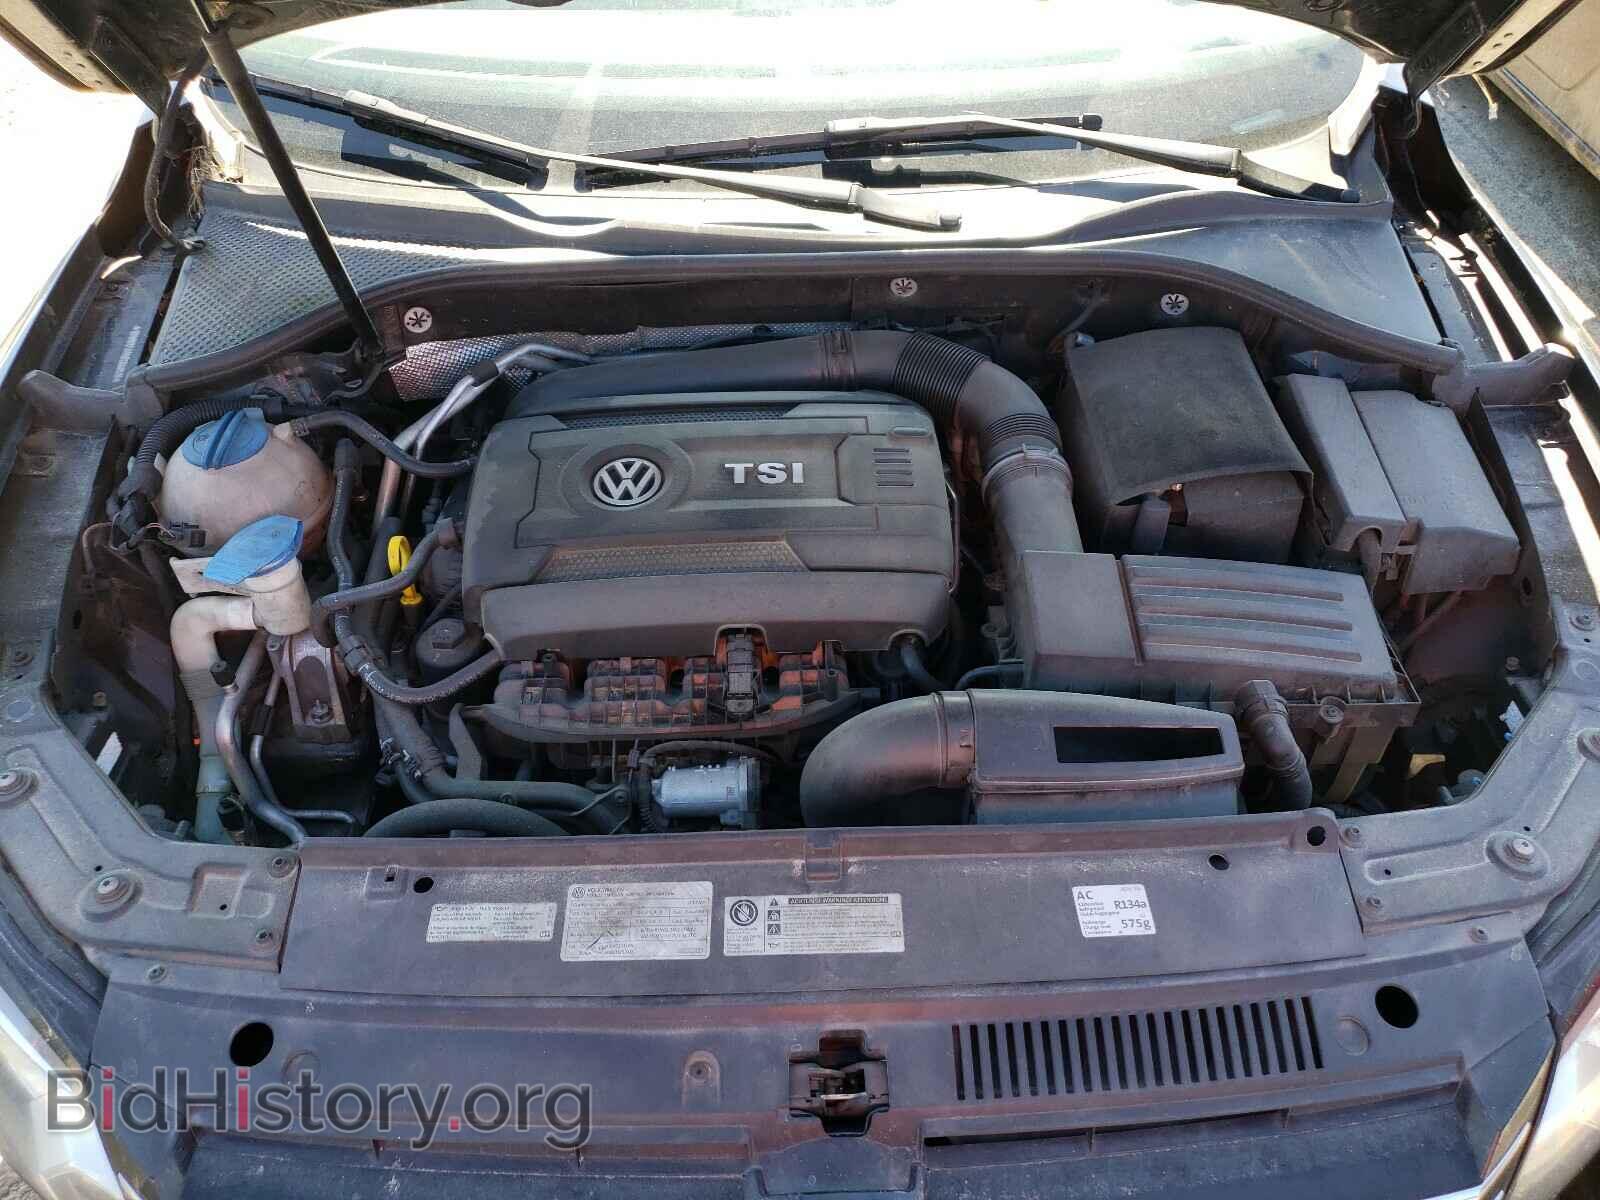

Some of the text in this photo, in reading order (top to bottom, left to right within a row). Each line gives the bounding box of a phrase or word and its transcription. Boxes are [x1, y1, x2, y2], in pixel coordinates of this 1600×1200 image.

[724, 462, 804, 484] TSI
[593, 457, 663, 506] VW
[1077, 890, 1094, 900] AC
[1113, 899, 1147, 910] R134a
[1121, 918, 1152, 930] 575g
